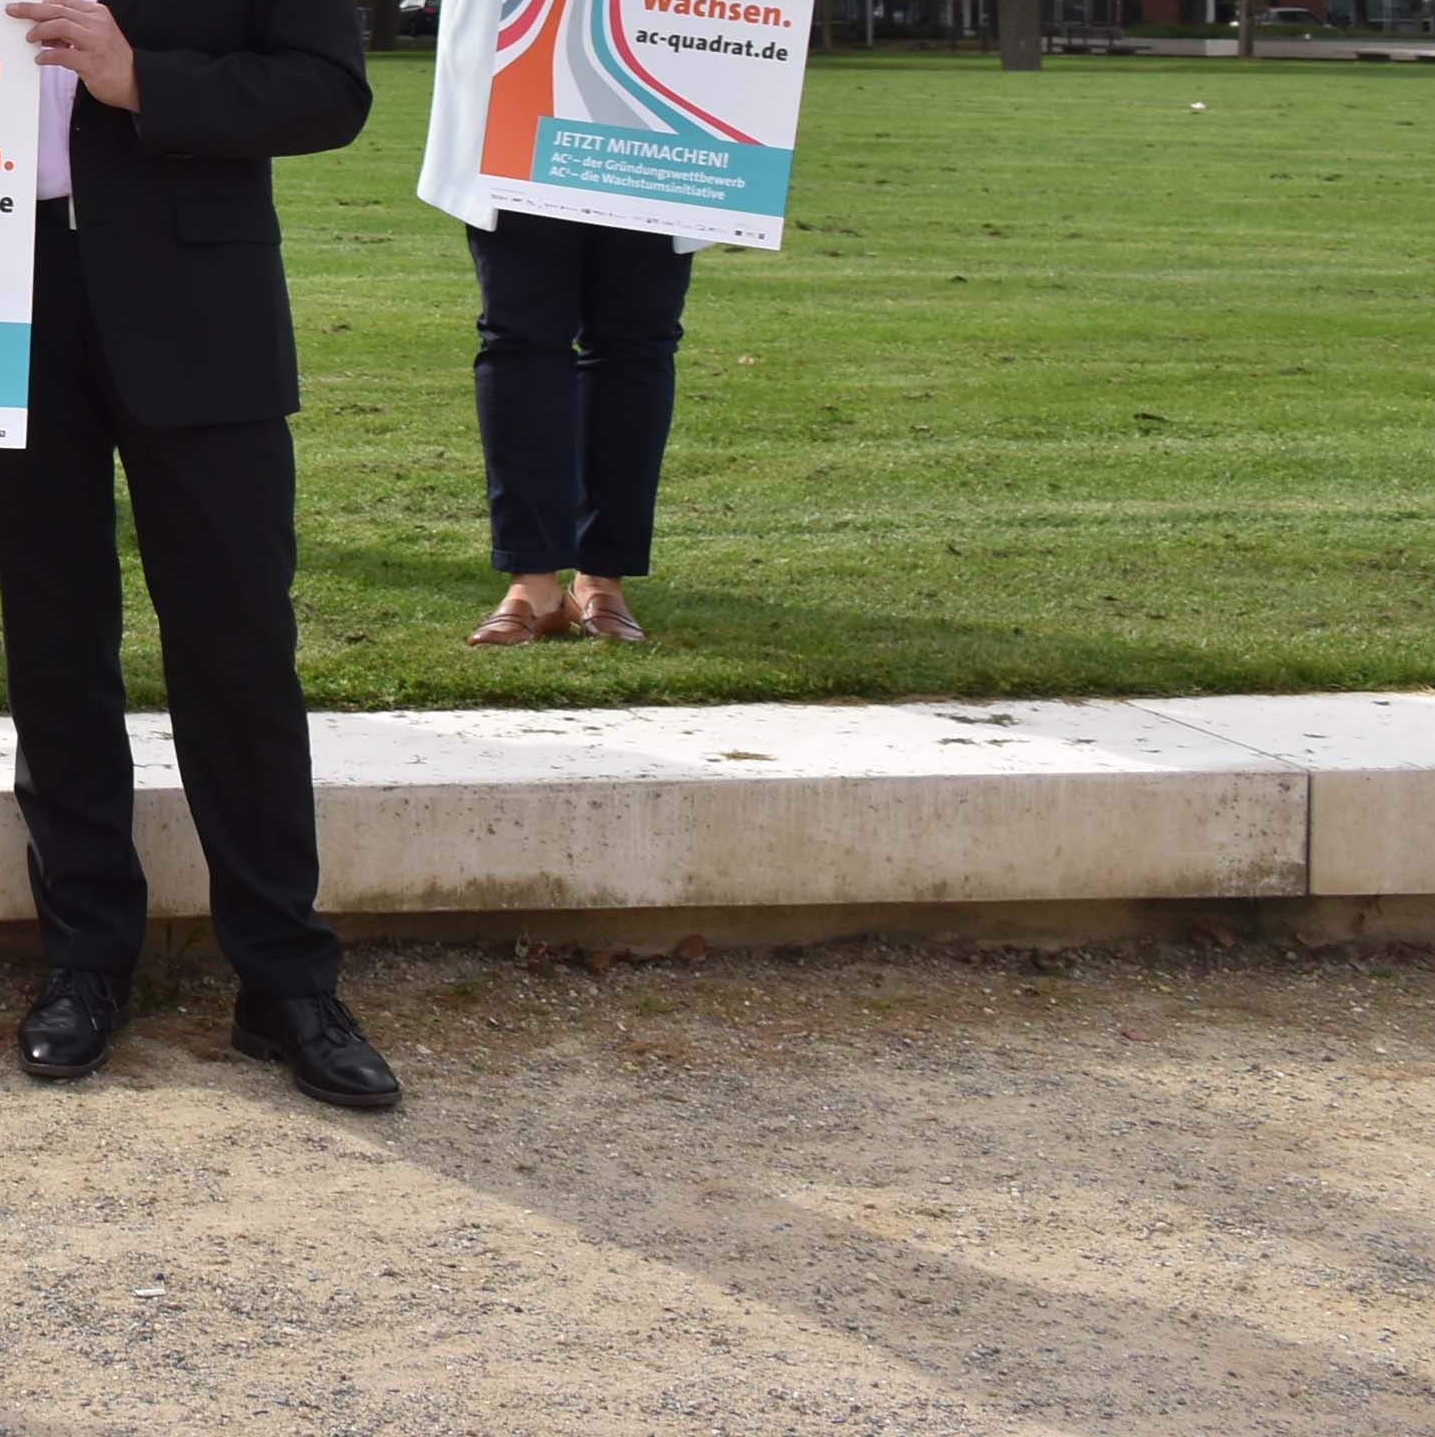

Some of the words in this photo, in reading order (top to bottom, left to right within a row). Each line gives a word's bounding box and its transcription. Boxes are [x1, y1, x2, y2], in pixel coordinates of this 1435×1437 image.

[635, 29, 789, 61] ac-quadrat.de
[553, 131, 604, 150] JETZT
[606, 138, 729, 168] MITMACHEN!
[582, 155, 603, 168] der
[580, 170, 600, 182] die
